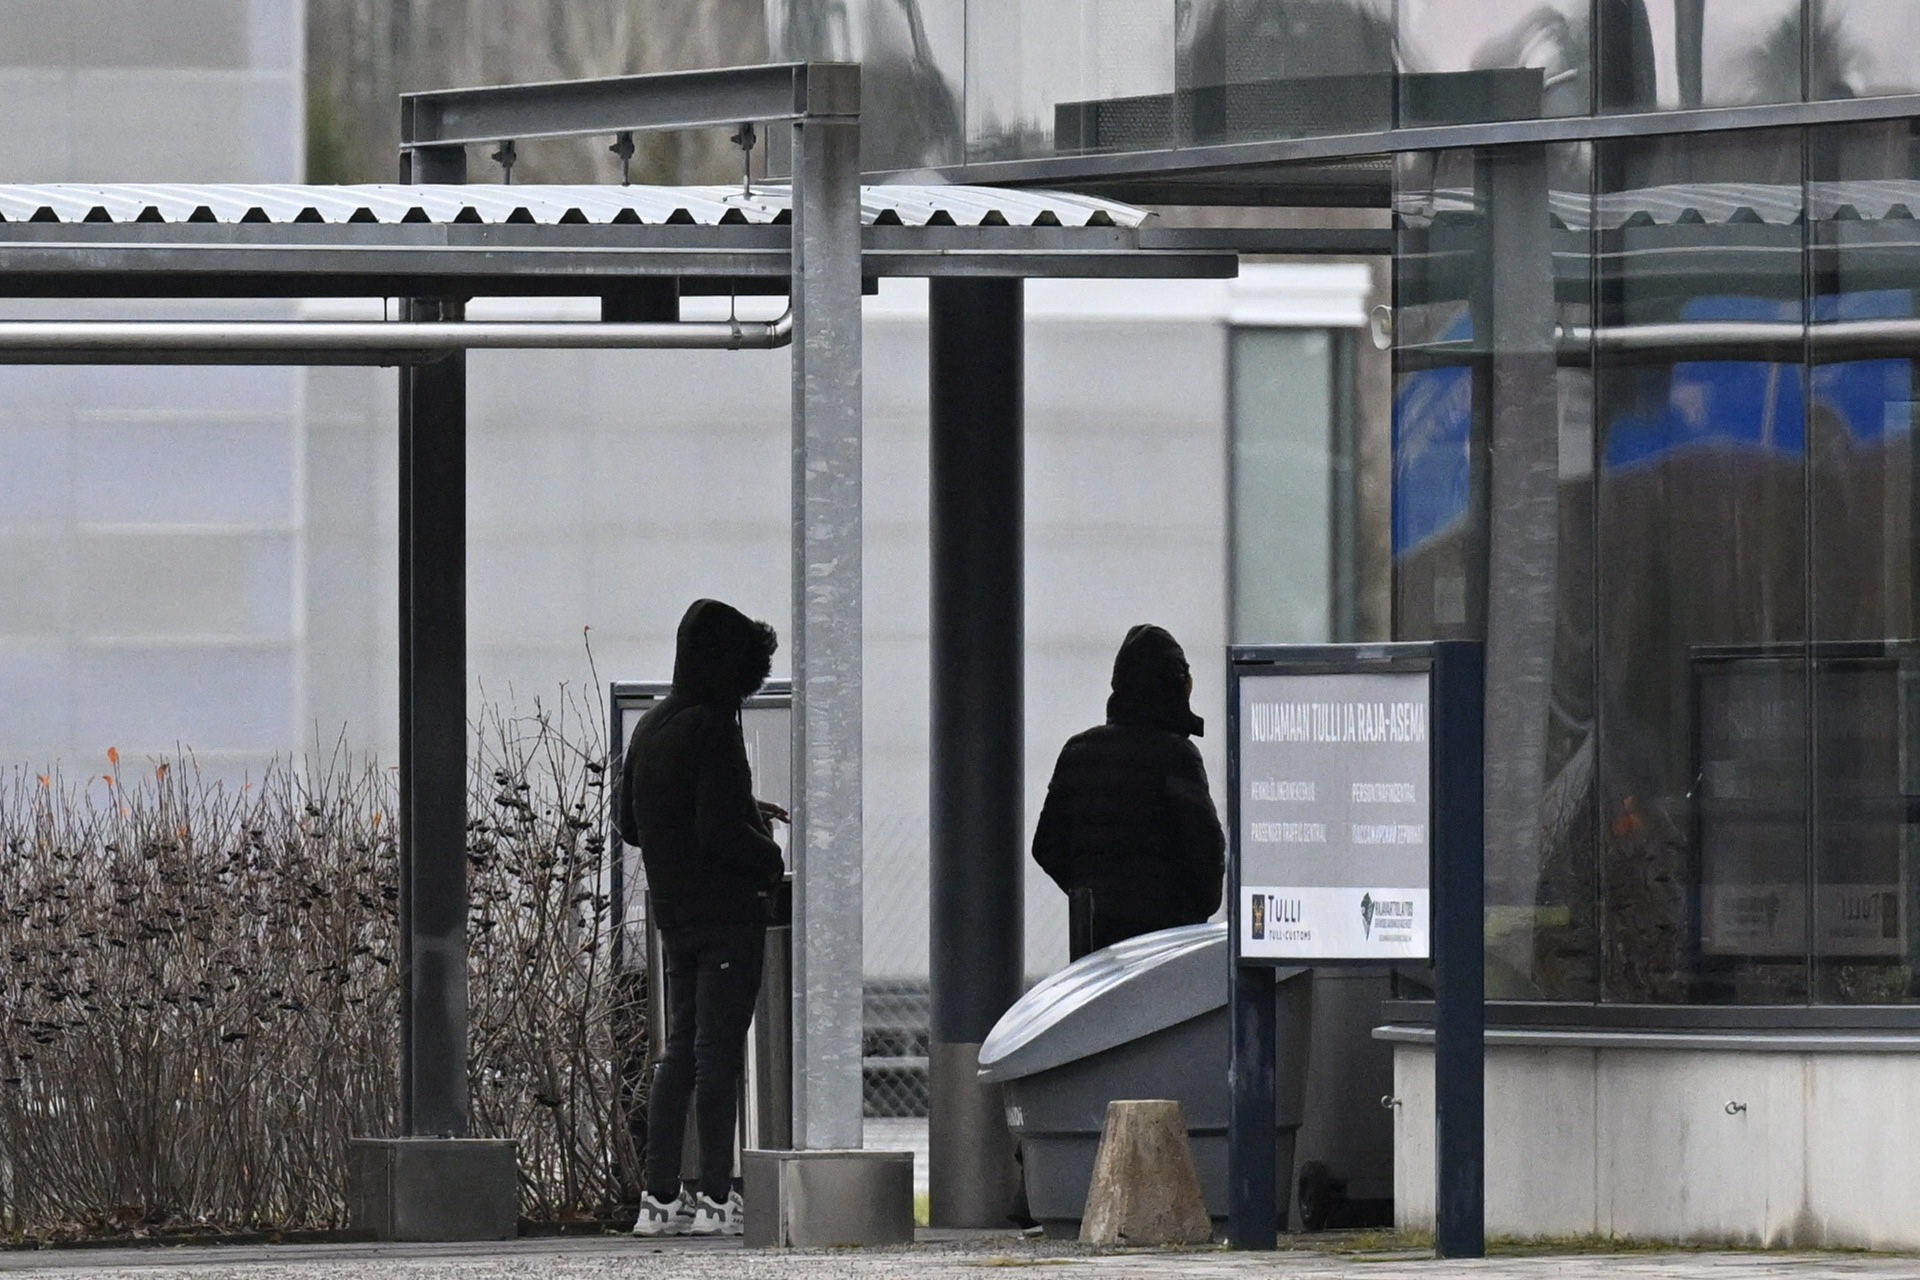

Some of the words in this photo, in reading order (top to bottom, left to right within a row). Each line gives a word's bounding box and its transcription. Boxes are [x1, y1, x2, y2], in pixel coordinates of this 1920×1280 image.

[1251, 702, 1310, 742] NUIJAMAAN
[1312, 702, 1341, 742] TULLI
[1342, 702, 1356, 742] JA
[1357, 702, 1425, 742] RAJA-ASEMA
[1268, 894, 1301, 922] TULLI
